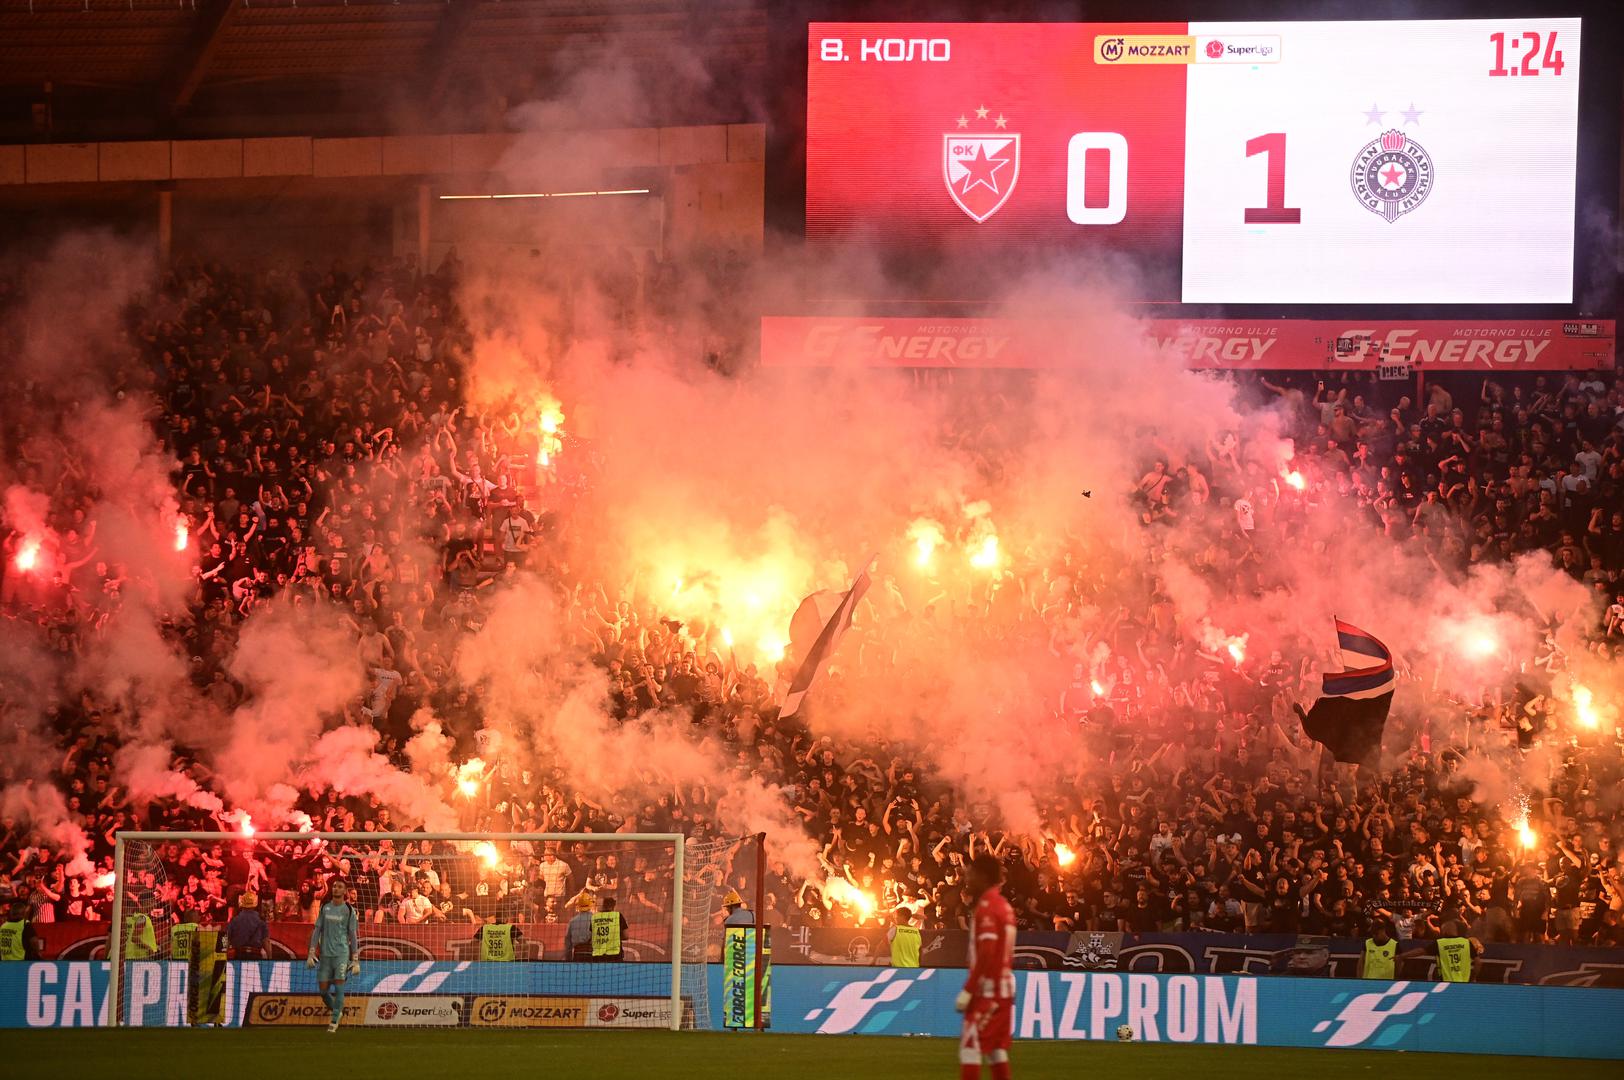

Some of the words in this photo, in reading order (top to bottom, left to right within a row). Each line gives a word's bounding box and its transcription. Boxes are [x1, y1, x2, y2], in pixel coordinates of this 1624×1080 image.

[820, 38, 850, 62] 8.
[860, 38, 951, 62] КОЛО
[1128, 45, 1190, 57] MOZZART
[1227, 44, 1273, 56] SuperLiga
[1489, 31, 1565, 76] 1:24
[1066, 131, 1129, 225] 0
[1243, 132, 1302, 224] 1
[1355, 146, 1379, 209] PARTIZAN
[1247, 327, 1278, 336] ULJE
[1453, 328, 1516, 337] MOTORNO
[1520, 328, 1552, 337] ULJE
[731, 934, 745, 976] FORCE
[288, 1005, 361, 1018] MOZZRT
[509, 1008, 581, 1019] MOZZART
[731, 981, 745, 1023] FORCE
[1011, 971, 1258, 1045] AZPROM
